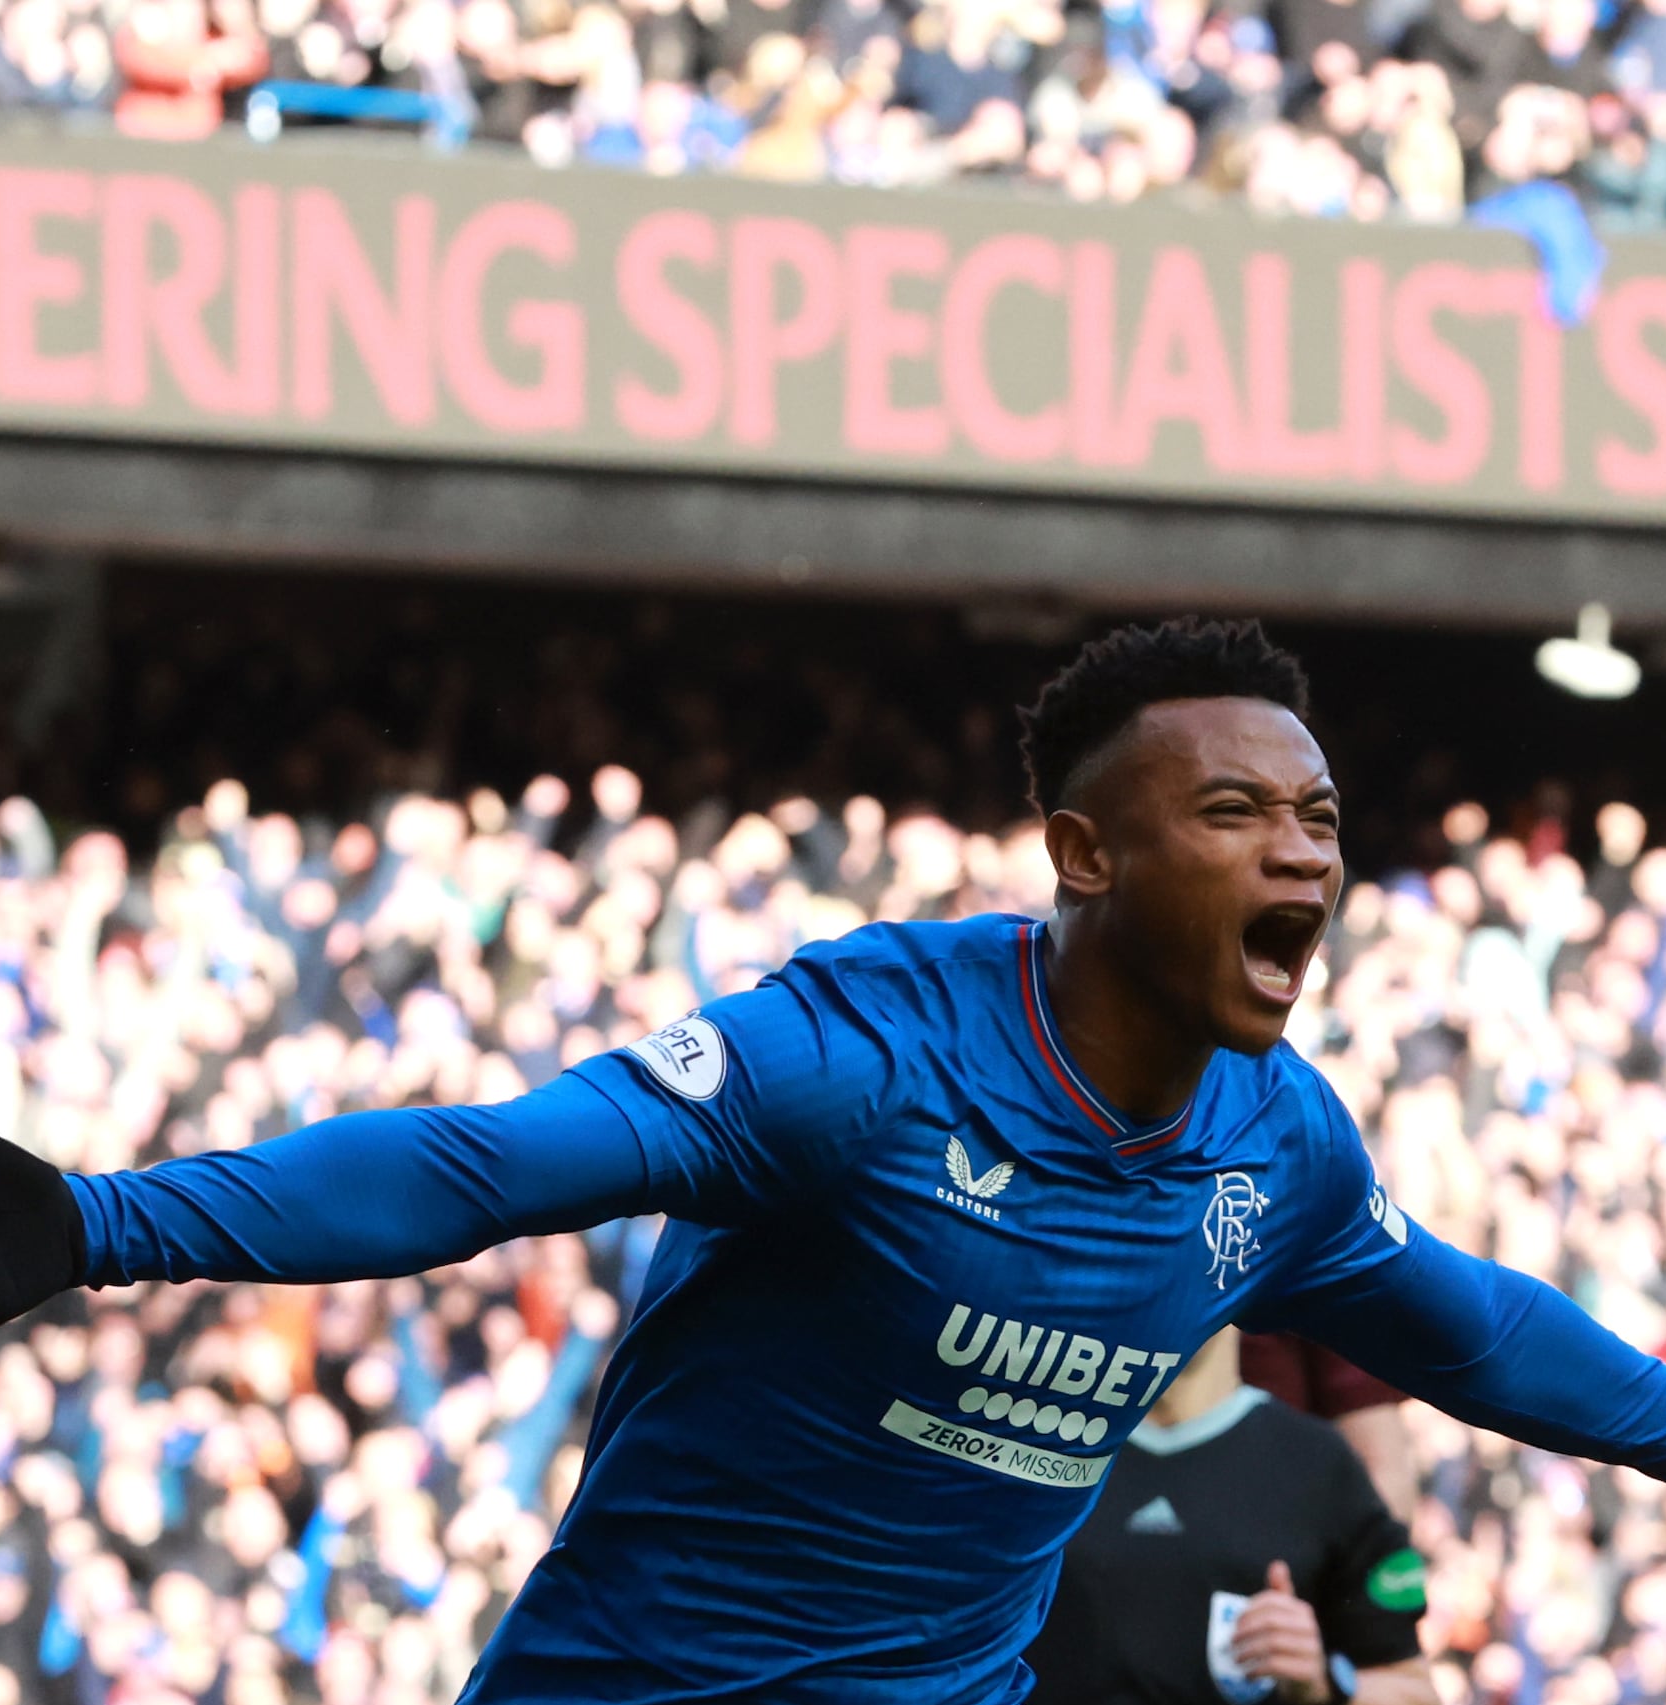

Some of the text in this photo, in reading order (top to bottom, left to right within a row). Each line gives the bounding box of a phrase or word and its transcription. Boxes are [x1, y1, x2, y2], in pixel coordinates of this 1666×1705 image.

[936, 1186, 1001, 1222] CASTORE
[936, 1303, 1182, 1408] UNIBET
[918, 1421, 1093, 1482] ZERO% MISSION
